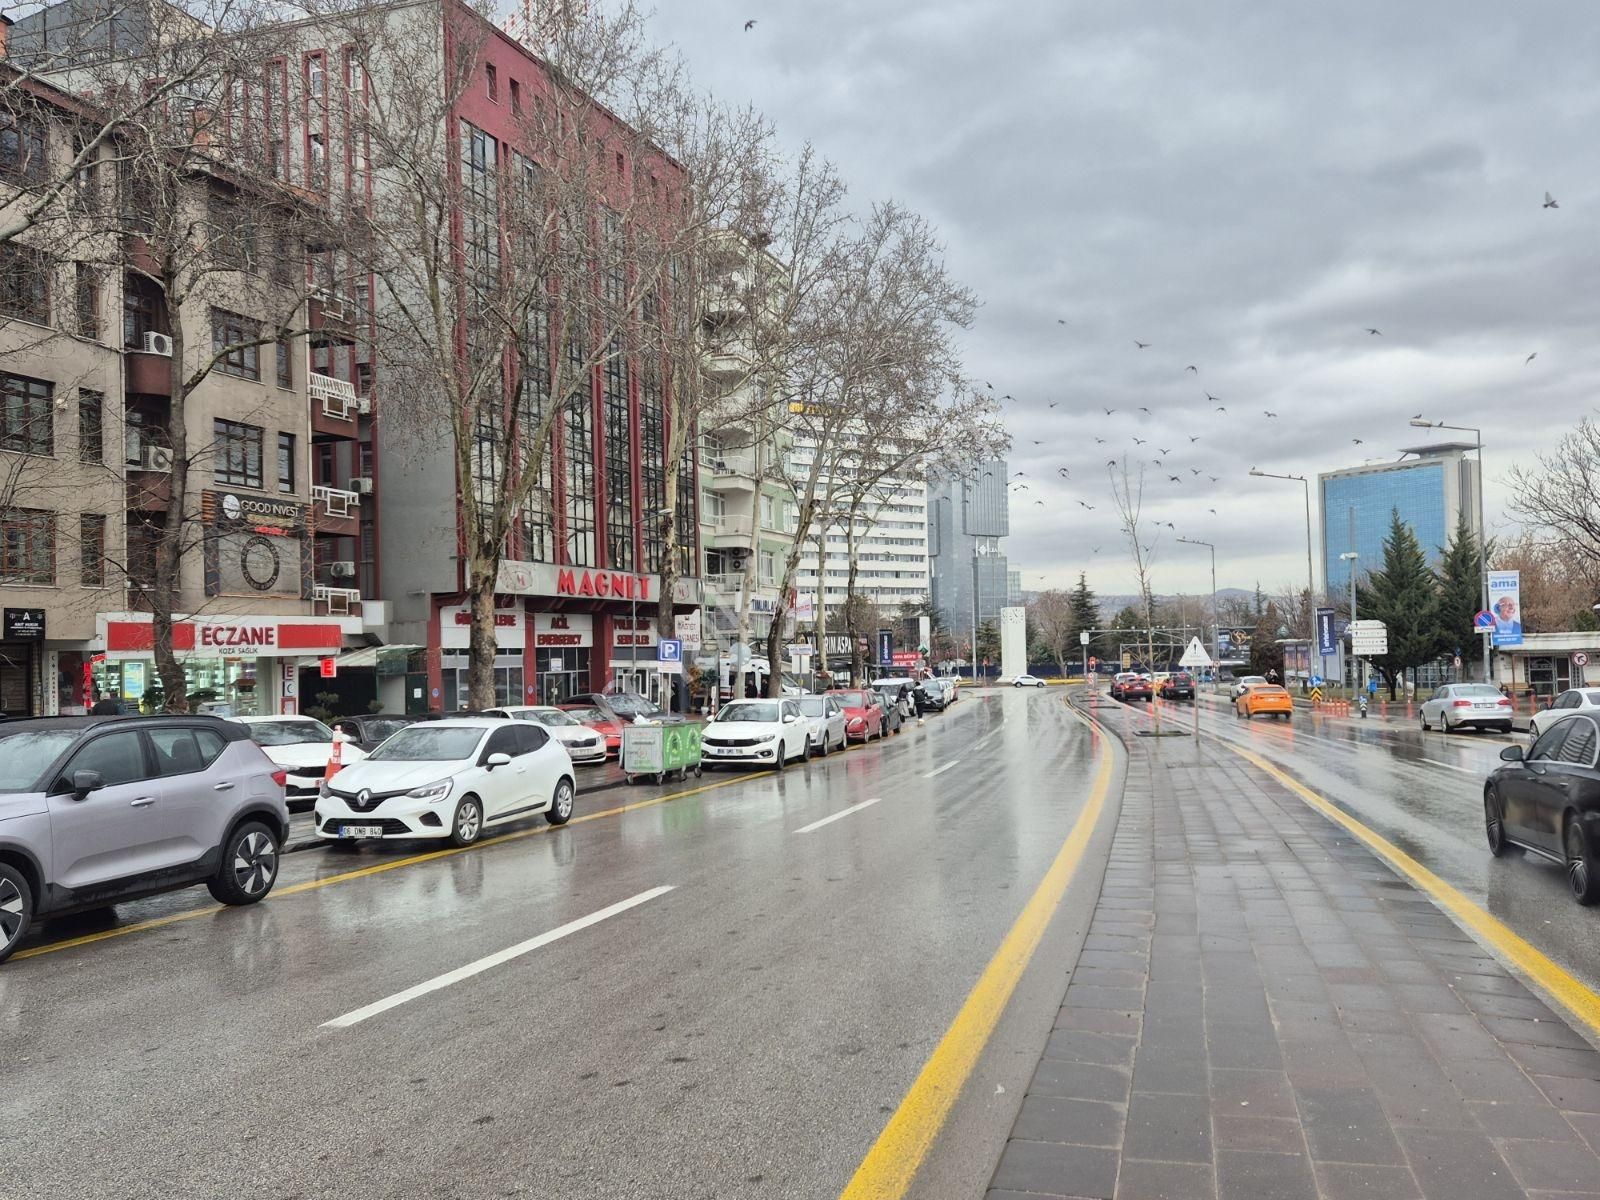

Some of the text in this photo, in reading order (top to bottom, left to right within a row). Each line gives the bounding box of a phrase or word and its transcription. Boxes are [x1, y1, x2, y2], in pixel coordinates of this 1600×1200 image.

[241, 500, 299, 517] GOOD INVEST
[1491, 580, 1517, 588] ama
[201, 626, 274, 646] ECZANE
[238, 647, 258, 655] SAĞLIK
[664, 643, 675, 658] P
